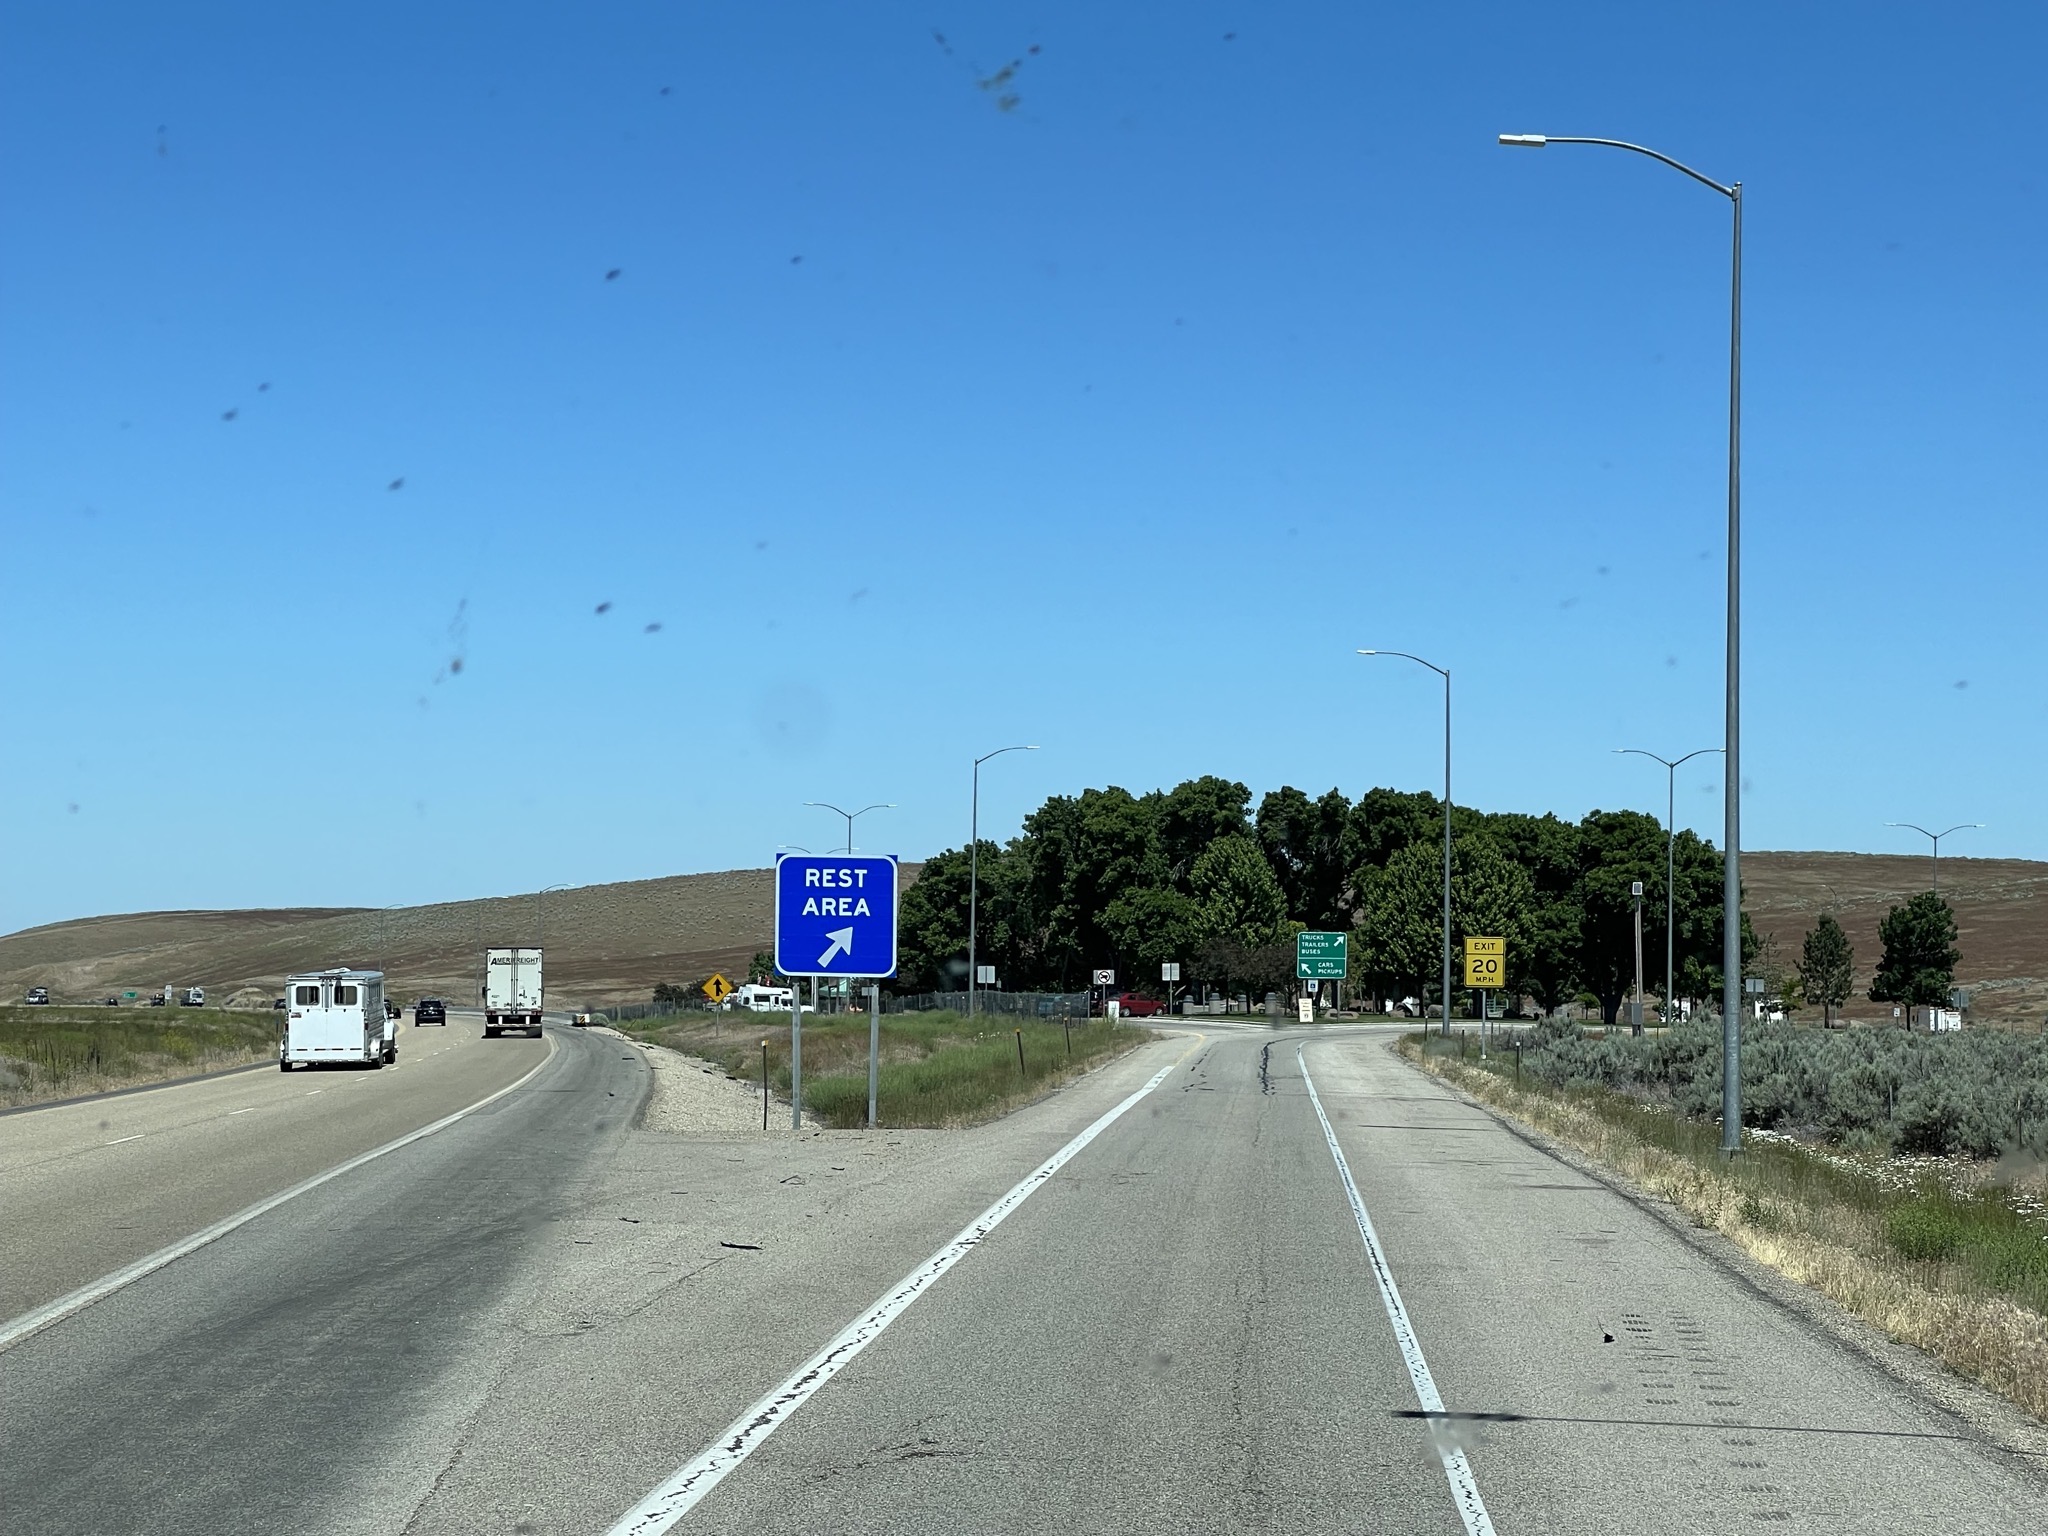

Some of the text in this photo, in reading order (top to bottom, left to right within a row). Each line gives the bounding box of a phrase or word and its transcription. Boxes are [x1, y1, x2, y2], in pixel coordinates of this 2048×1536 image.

[805, 868, 868, 888] REST
[802, 897, 871, 917] AREA
[1474, 942, 1496, 951] EXIT
[490, 957, 539, 965] AMERIREIGHT
[1472, 959, 1498, 974] 20
